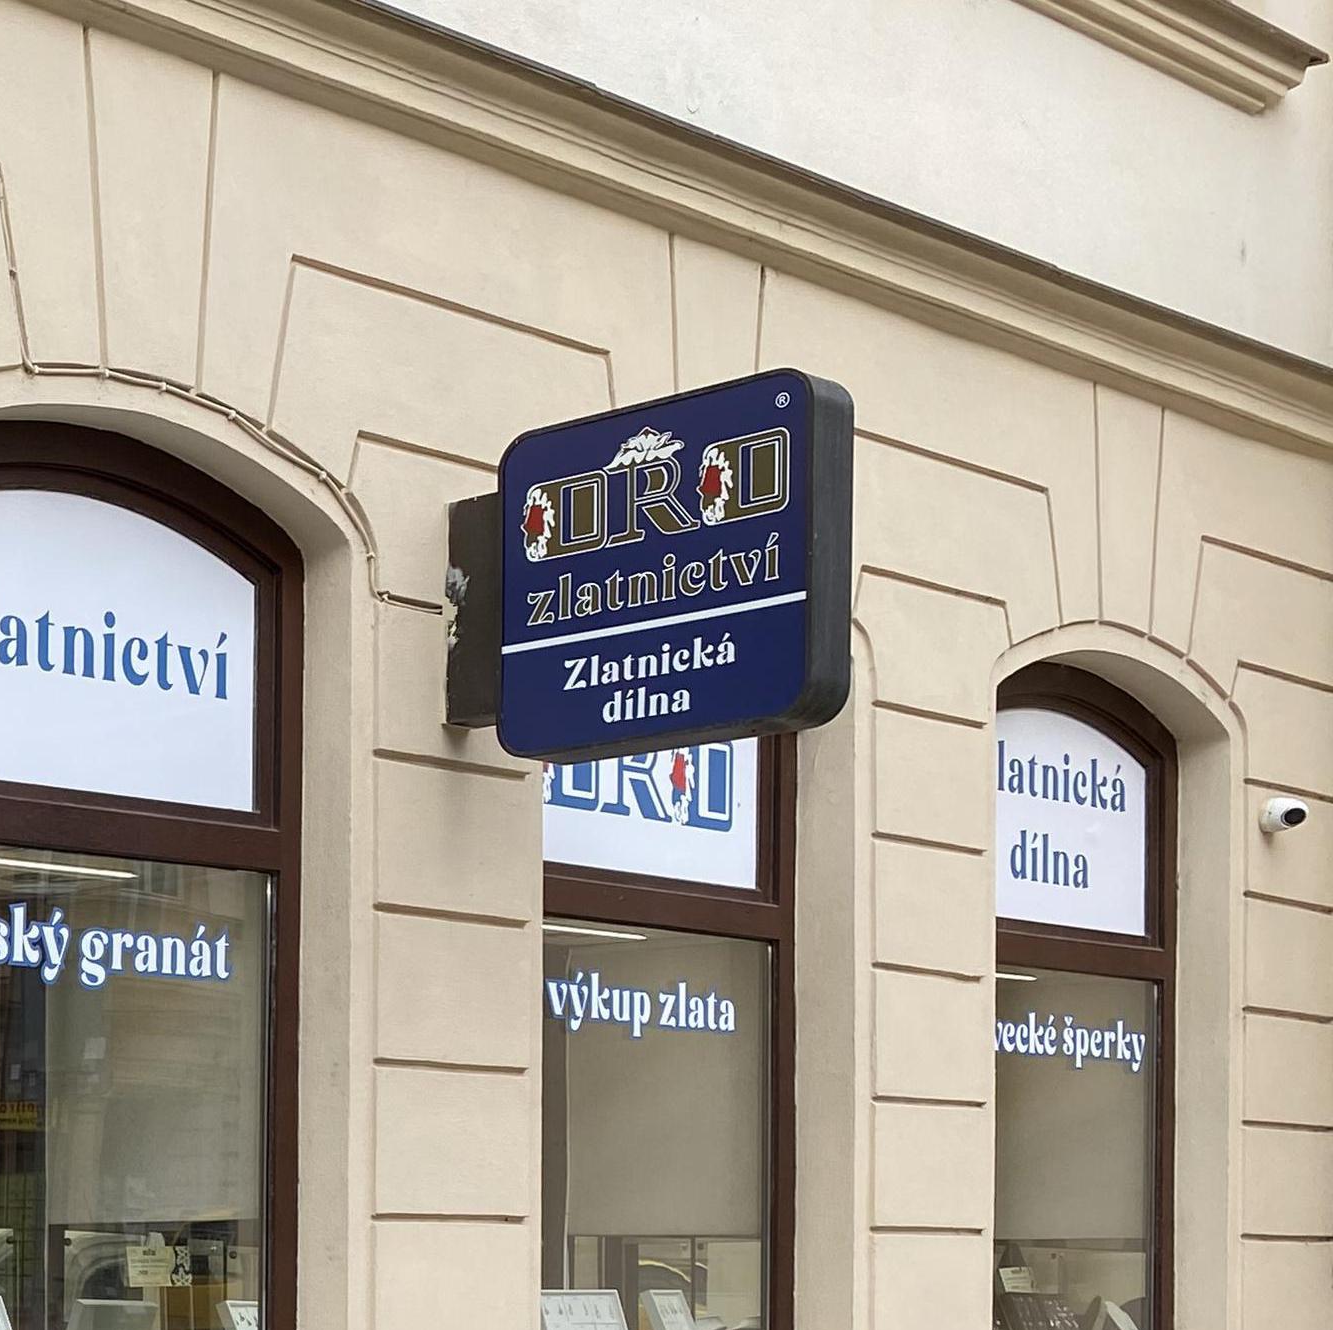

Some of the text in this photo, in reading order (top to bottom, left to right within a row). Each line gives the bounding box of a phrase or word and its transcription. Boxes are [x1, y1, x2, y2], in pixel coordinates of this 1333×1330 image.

[526, 532, 780, 627] zlatnictví
[563, 633, 736, 691] Zlatnická
[602, 688, 691, 723] dílna
[997, 740, 1127, 813] latnická
[1009, 829, 1090, 889] dílna
[79, 925, 232, 989] granát
[545, 971, 736, 1038] výkup zlata
[1063, 1016, 1146, 1072] šperky
